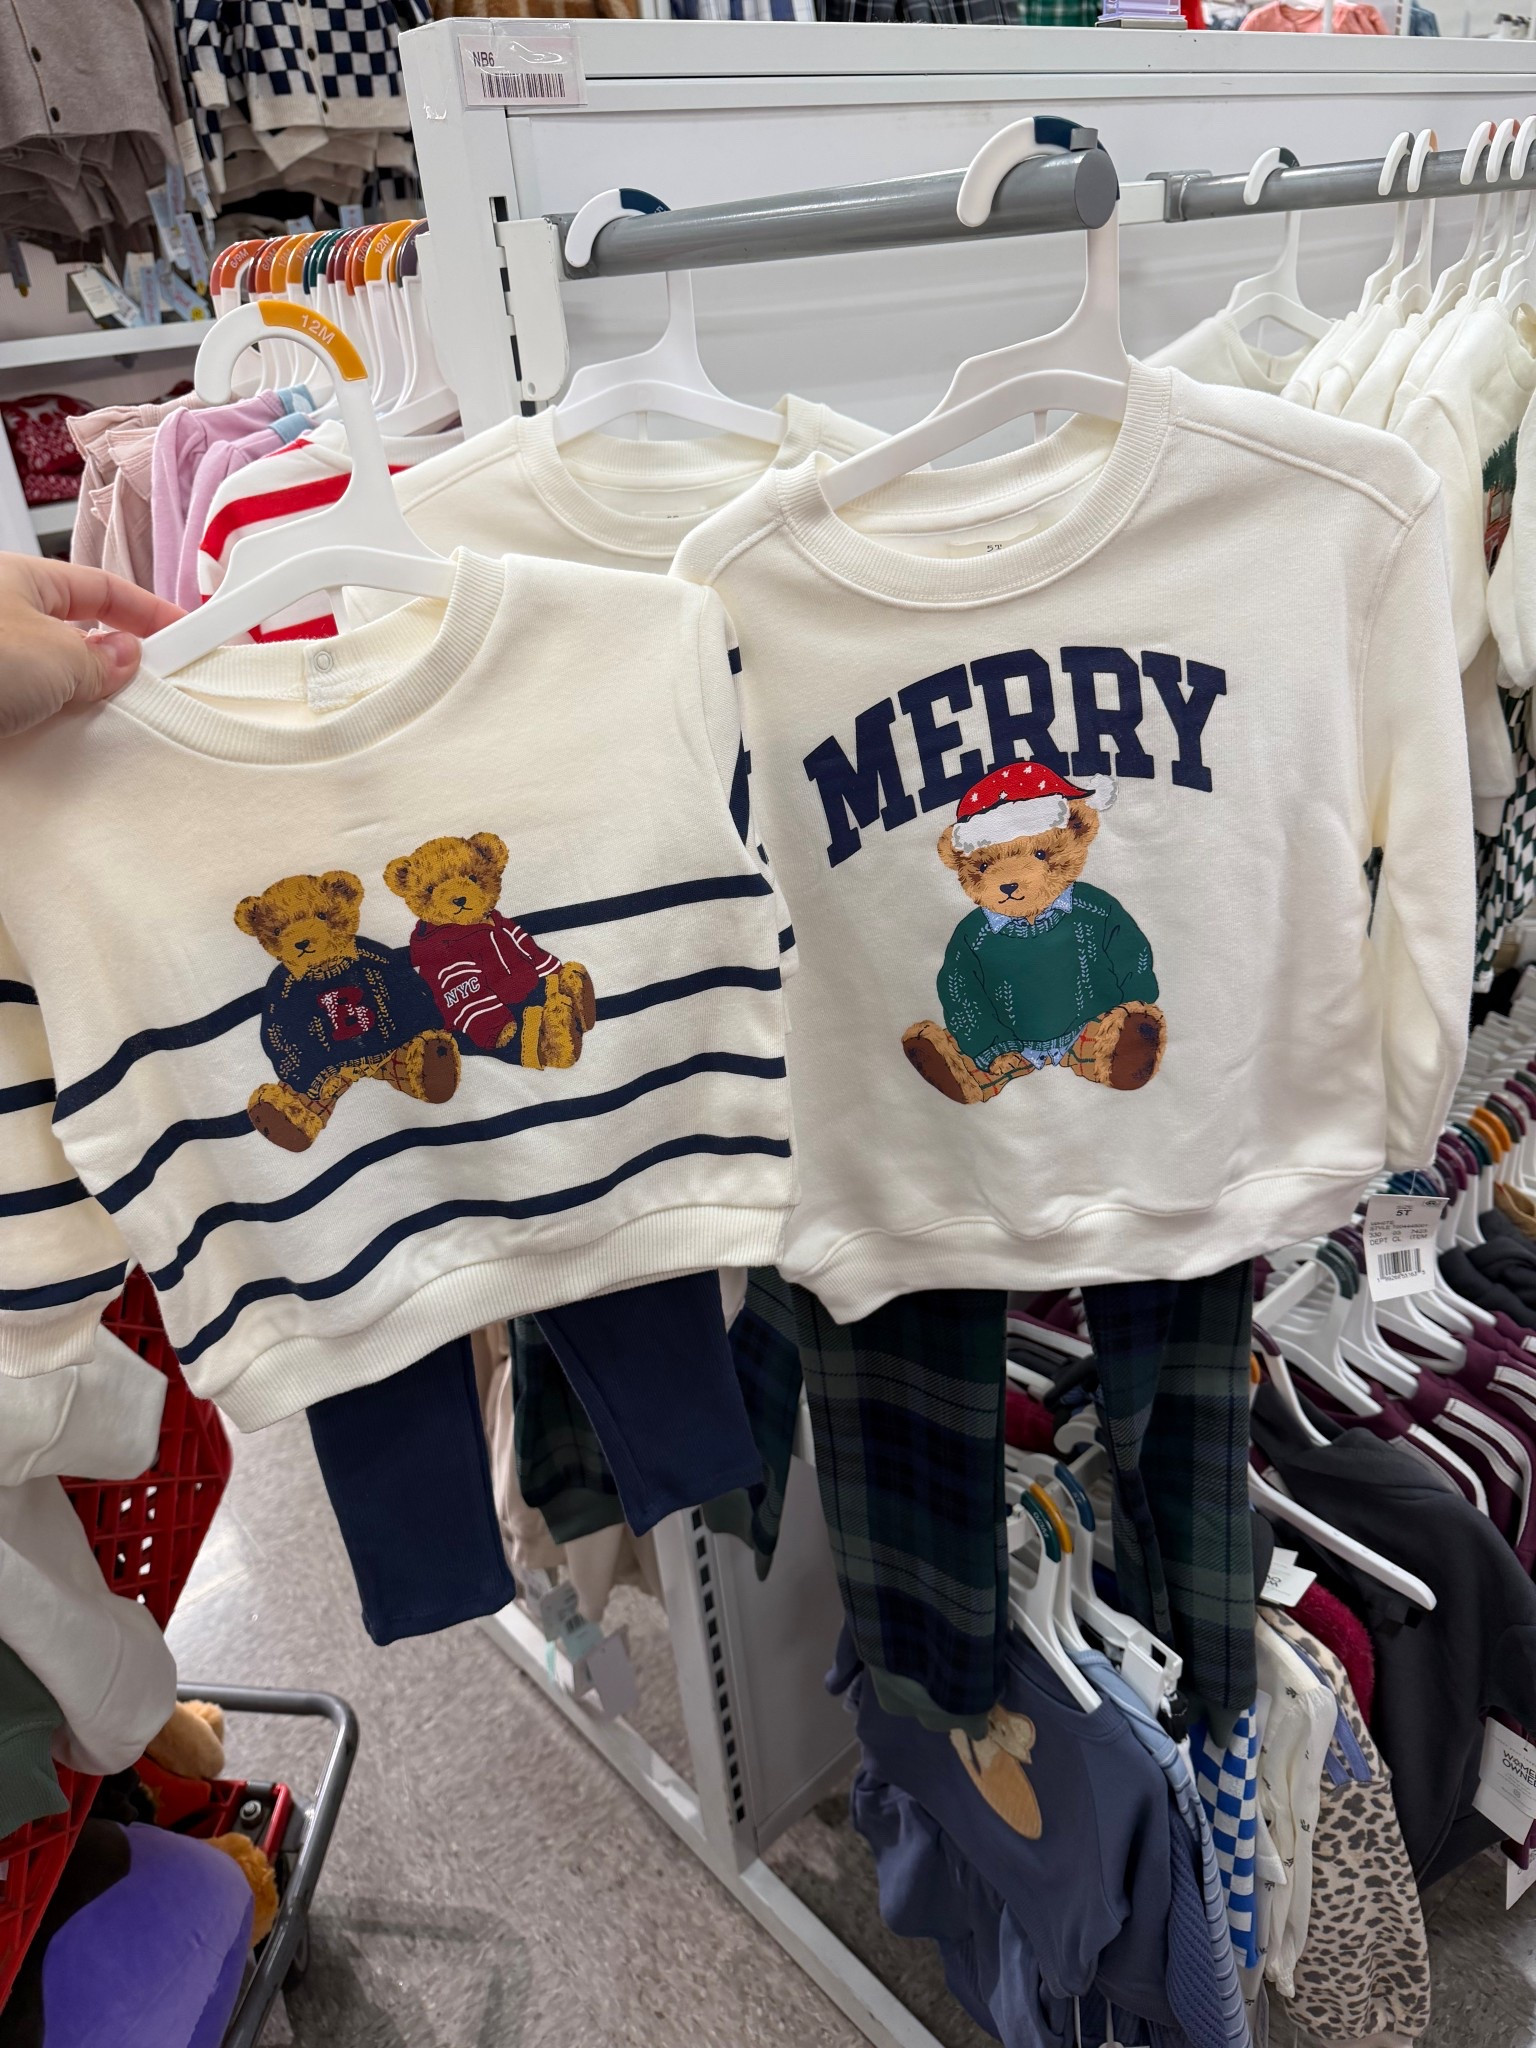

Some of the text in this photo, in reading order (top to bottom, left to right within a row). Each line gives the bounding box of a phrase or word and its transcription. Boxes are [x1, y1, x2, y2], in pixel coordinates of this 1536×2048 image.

[472, 51, 495, 67] NB6
[374, 233, 391, 255] 12M
[229, 248, 250, 269] 6/9M
[302, 314, 336, 345] 12M
[802, 646, 1227, 868] MERRY
[444, 976, 481, 1009] NYC
[1370, 1237, 1387, 1245] DEPT
[1503, 1749, 1536, 1780] WOME
